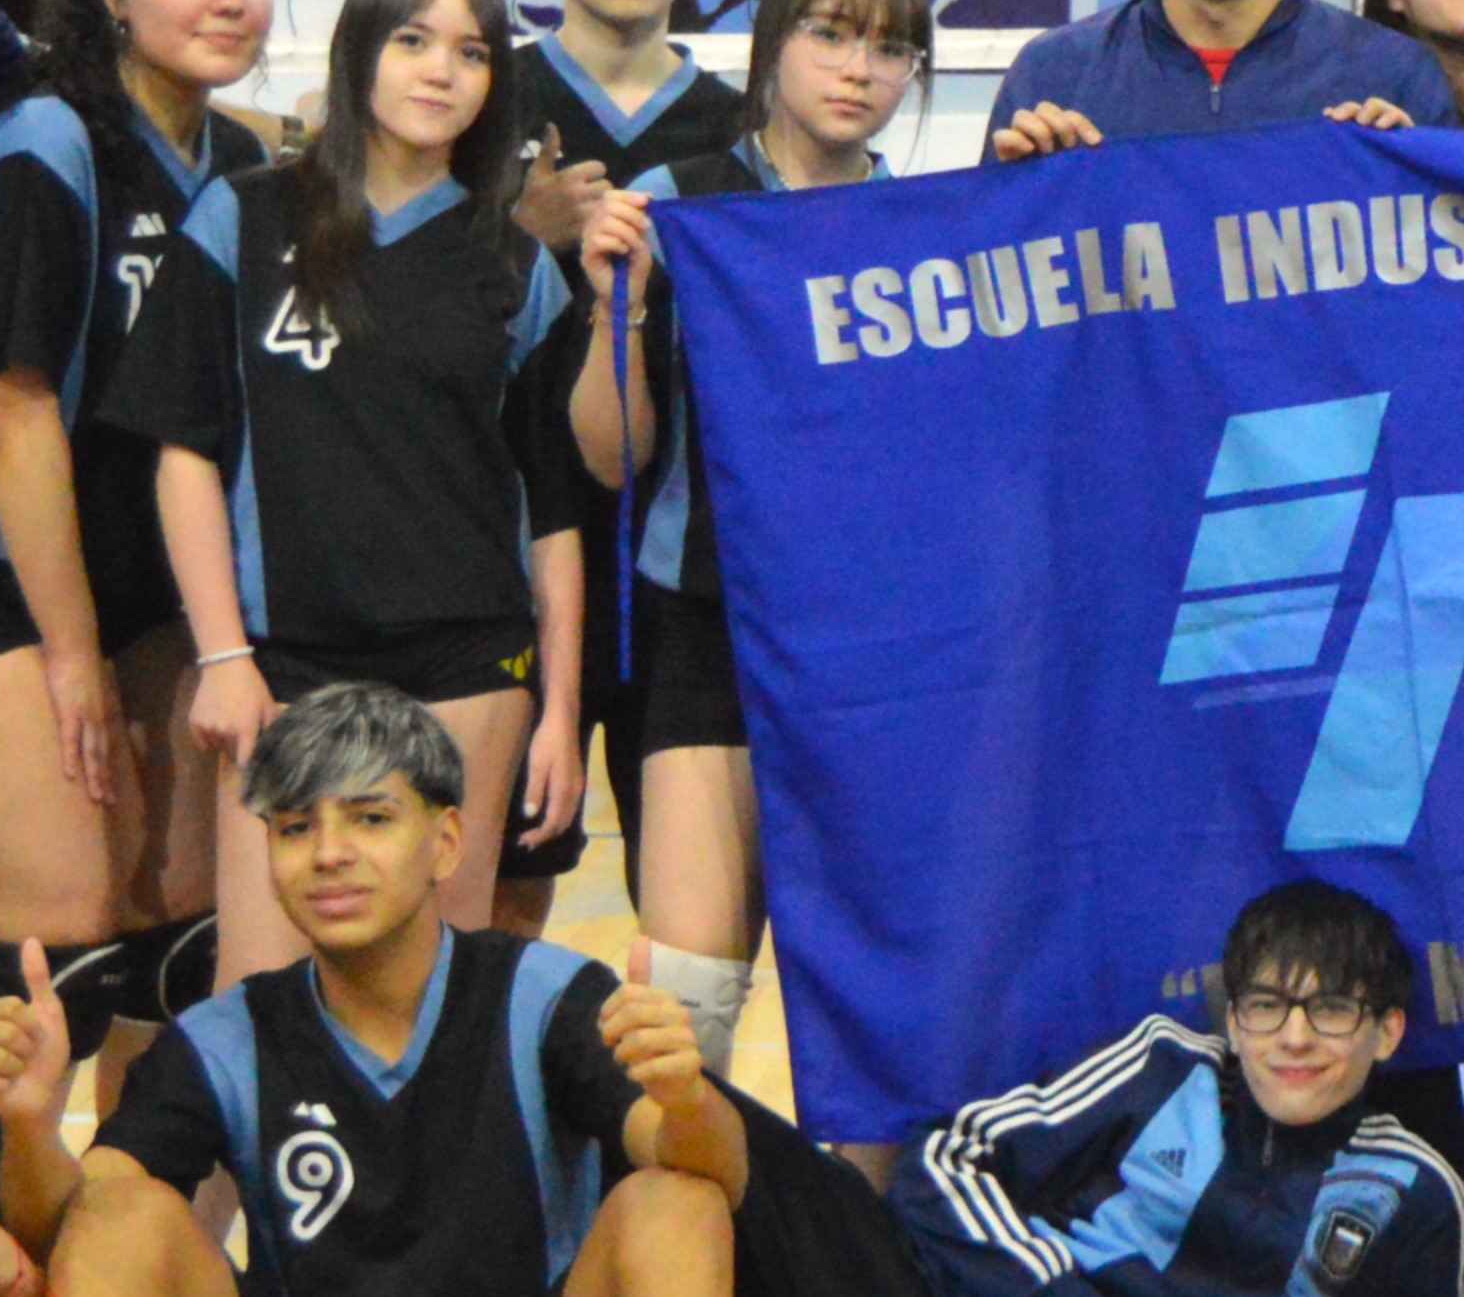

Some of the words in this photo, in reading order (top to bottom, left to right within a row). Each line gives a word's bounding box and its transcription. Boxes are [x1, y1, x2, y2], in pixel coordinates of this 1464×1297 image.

[263, 285, 342, 372] 4
[804, 221, 1176, 366] ESCUELA
[277, 1130, 355, 1242] 9
